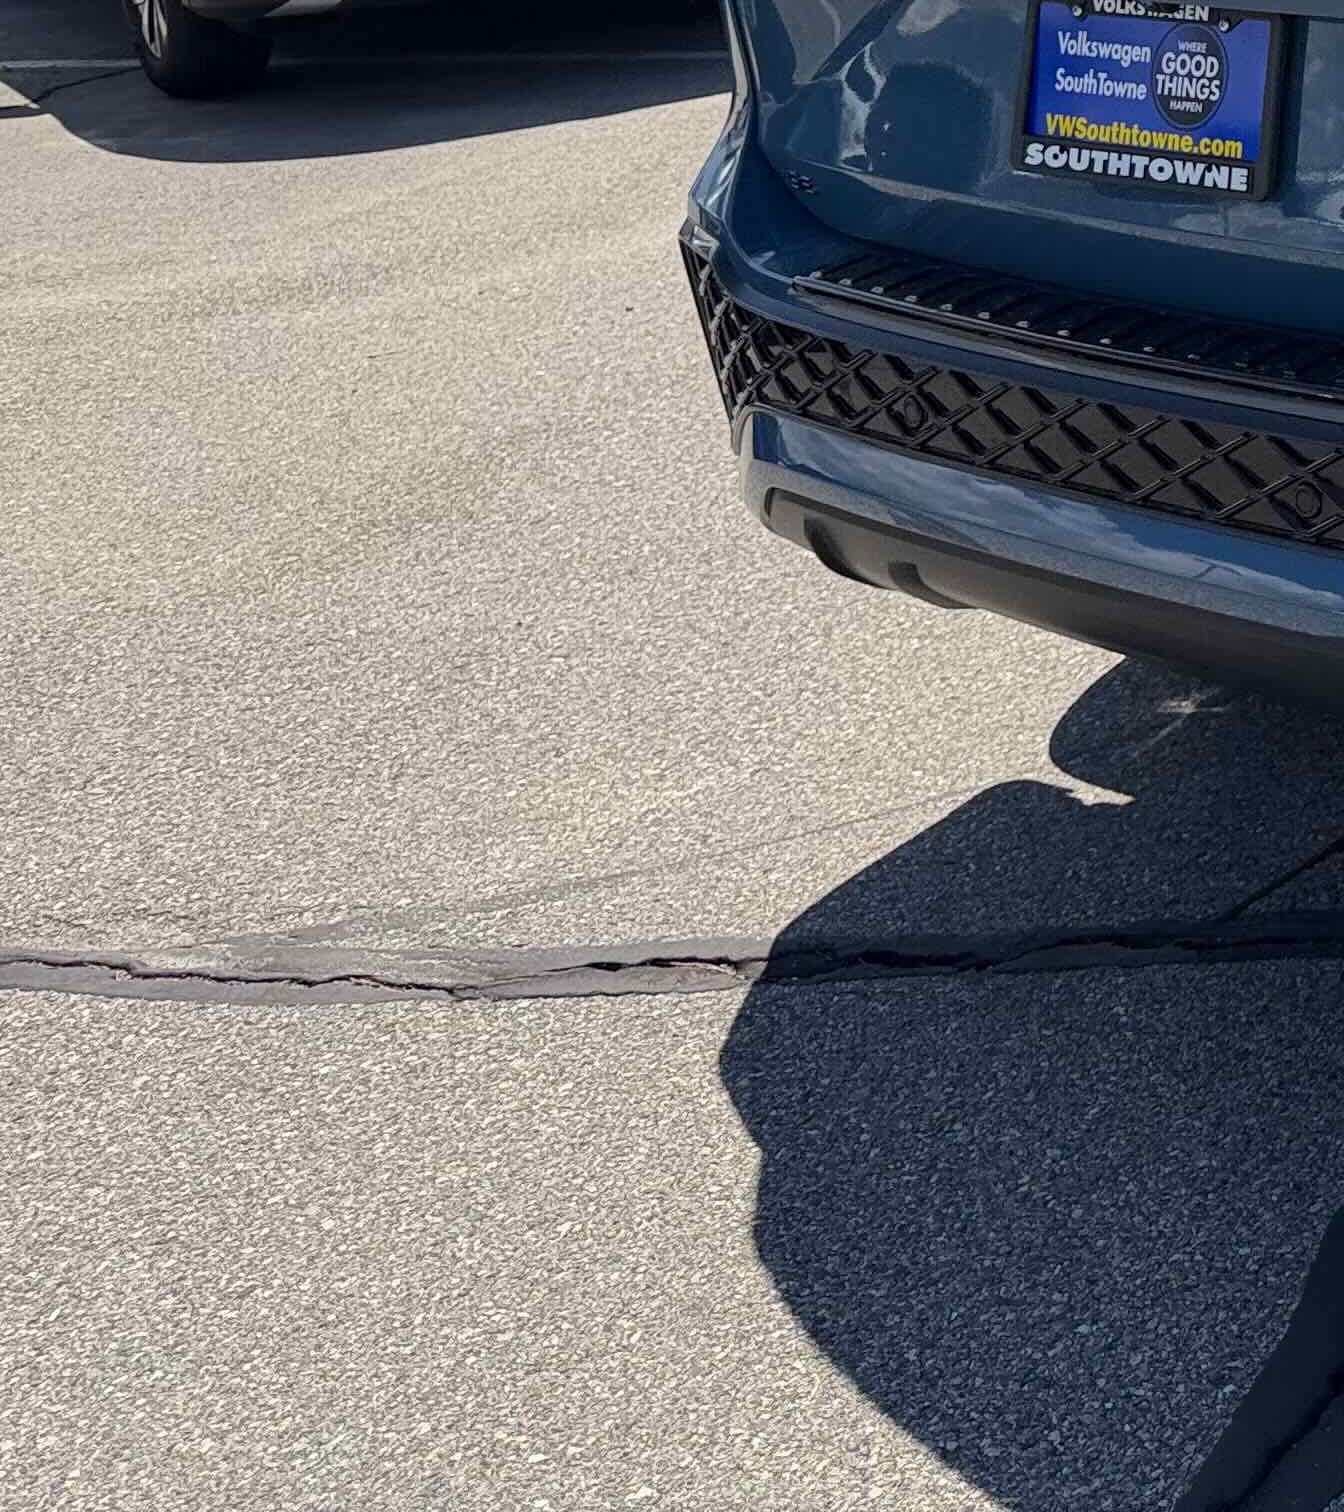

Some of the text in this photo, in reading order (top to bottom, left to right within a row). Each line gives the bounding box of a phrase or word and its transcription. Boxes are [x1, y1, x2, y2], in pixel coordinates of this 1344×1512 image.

[1057, 31, 1151, 68] Volkswagen
[1178, 39, 1208, 54] WHERE
[1161, 52, 1219, 78] GOOD
[1055, 68, 1147, 101] SouthTowne
[1155, 73, 1221, 102] THINGS
[1169, 99, 1203, 113] HAPPEN
[1046, 112, 1243, 159] VWSouthtowne.com
[1023, 142, 1250, 192] SOUTHTOWNE
